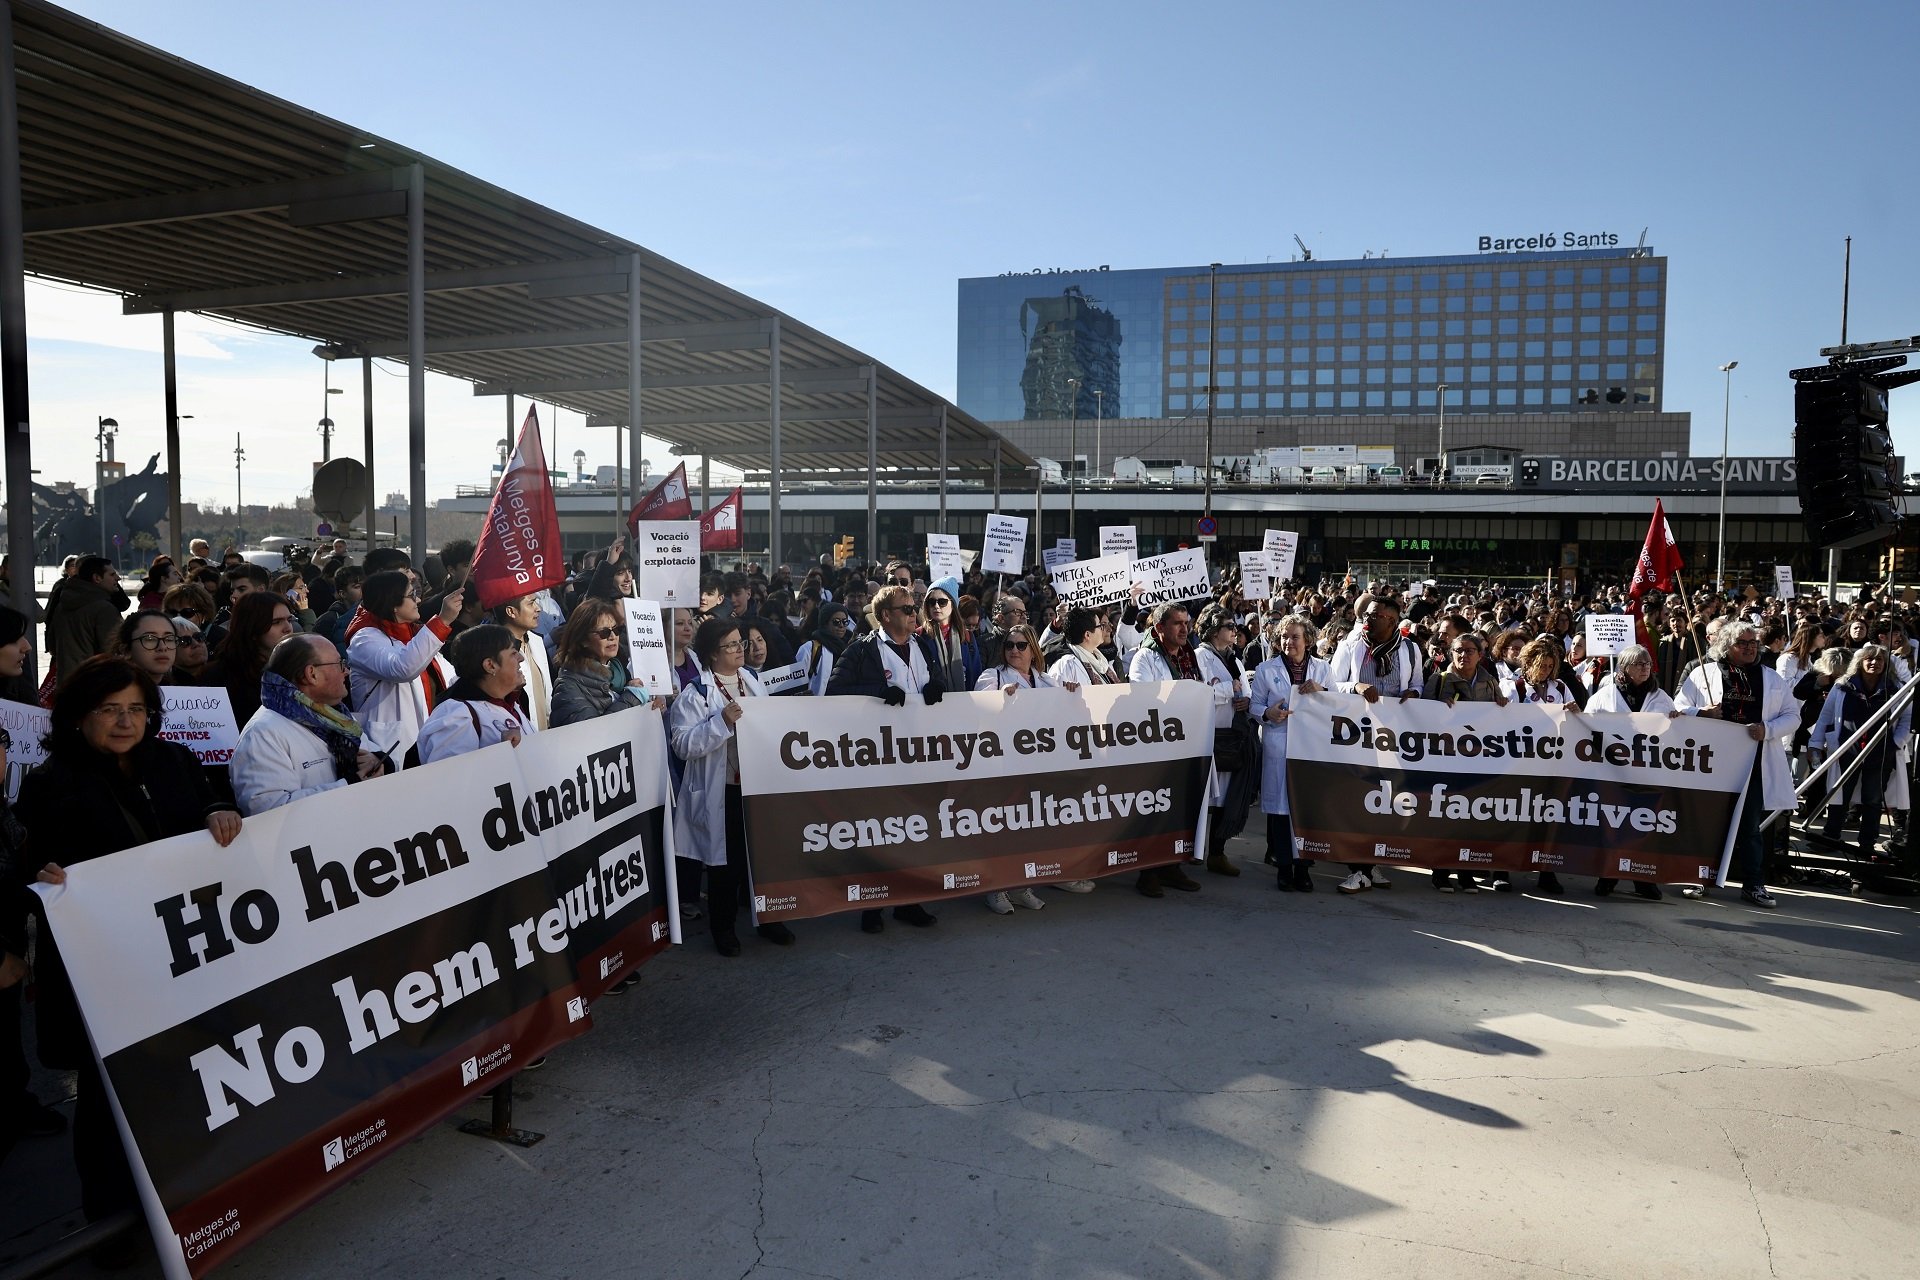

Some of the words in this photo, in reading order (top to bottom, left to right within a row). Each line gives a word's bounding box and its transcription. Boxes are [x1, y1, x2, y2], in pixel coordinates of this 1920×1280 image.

[1479, 232, 1556, 250] Barceló
[1563, 231, 1618, 247] Sants
[504, 478, 539, 550] Metges
[650, 532, 690, 541] Vocació
[671, 544, 682, 553] és
[644, 556, 696, 568] explotació
[1132, 557, 1167, 573] MENYS
[1160, 557, 1194, 578] PRESSIÓ
[1076, 570, 1125, 590] EXPLOTATS
[1058, 585, 1104, 602] PACIENTS
[1068, 588, 1131, 610] MALTRACTATS
[1138, 576, 1208, 606] CONCILIACIÓ
[631, 610, 656, 621] Vocació
[637, 626, 646, 634] no
[646, 625, 653, 635] és
[632, 638, 664, 650] explotació
[770, 674, 793, 685] donat
[794, 670, 805, 679] tot
[164, 717, 186, 730] hace
[188, 715, 226, 729] bromas
[158, 730, 211, 741] CORTARSE
[779, 725, 1003, 770] Catalunya
[1012, 725, 1056, 755] es
[1065, 708, 1186, 760] queda
[1330, 715, 1565, 762] Diagnòstic:
[1574, 731, 1714, 774] dèficit
[1364, 779, 1418, 817] de
[1428, 784, 1678, 834] facultatives
[802, 813, 929, 853] sense
[937, 784, 1172, 839] facultatives
[1304, 840, 1323, 848] Metges
[154, 882, 280, 979] Ho
[290, 824, 470, 923] hem
[593, 748, 632, 805] tot
[1036, 864, 1053, 872] Metges
[1631, 862, 1650, 870] Metges
[955, 875, 971, 883] Metges
[955, 880, 980, 889] Catalunya
[860, 885, 881, 895] Metges
[881, 884, 889, 892] de
[860, 891, 889, 901] Catalunya
[766, 896, 787, 906] Metges
[766, 902, 797, 912] Catalunya
[190, 1023, 325, 1132] No
[332, 940, 501, 1055] hem
[602, 850, 644, 908] res
[478, 1049, 502, 1067] Metges
[502, 1042, 511, 1053] de
[479, 1052, 512, 1077] Catalunya
[344, 1125, 374, 1148] Metges
[375, 1117, 386, 1129] de
[345, 1129, 387, 1160] Catalunya
[183, 1217, 224, 1247] Metges
[225, 1208, 238, 1221] de
[187, 1220, 241, 1260] Catalunya
